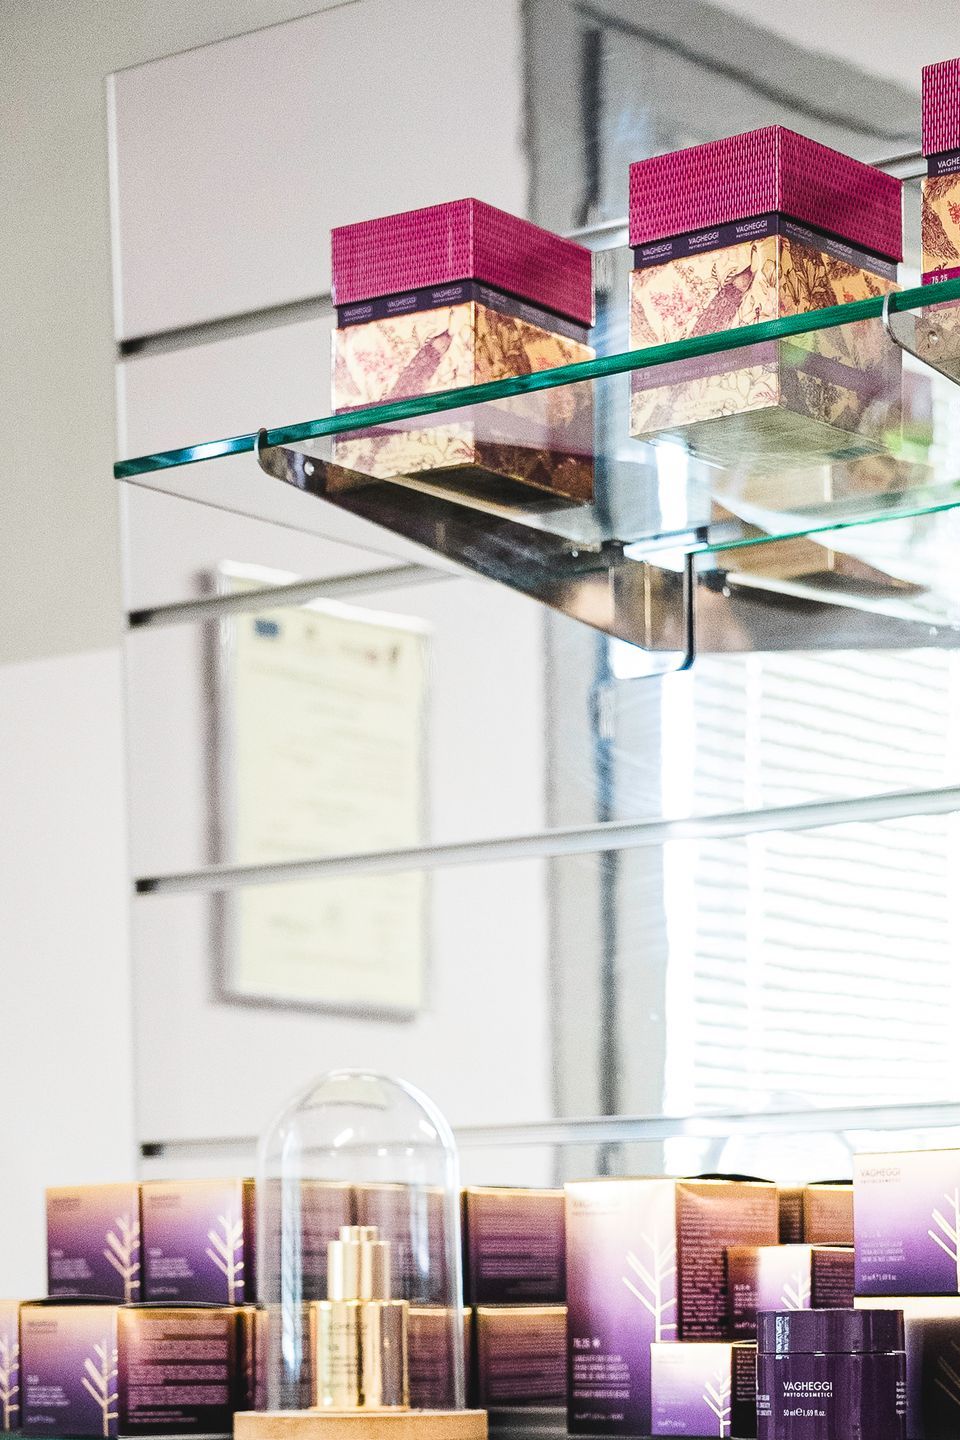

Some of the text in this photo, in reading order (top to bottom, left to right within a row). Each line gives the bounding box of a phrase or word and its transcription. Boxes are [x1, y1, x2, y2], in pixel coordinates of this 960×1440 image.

[688, 232, 719, 244] VAGHEGGI
[736, 220, 767, 233] VAGHEGGI
[930, 273, 948, 284] 75.25
[783, 1381, 833, 1391] VAGHEGGI
